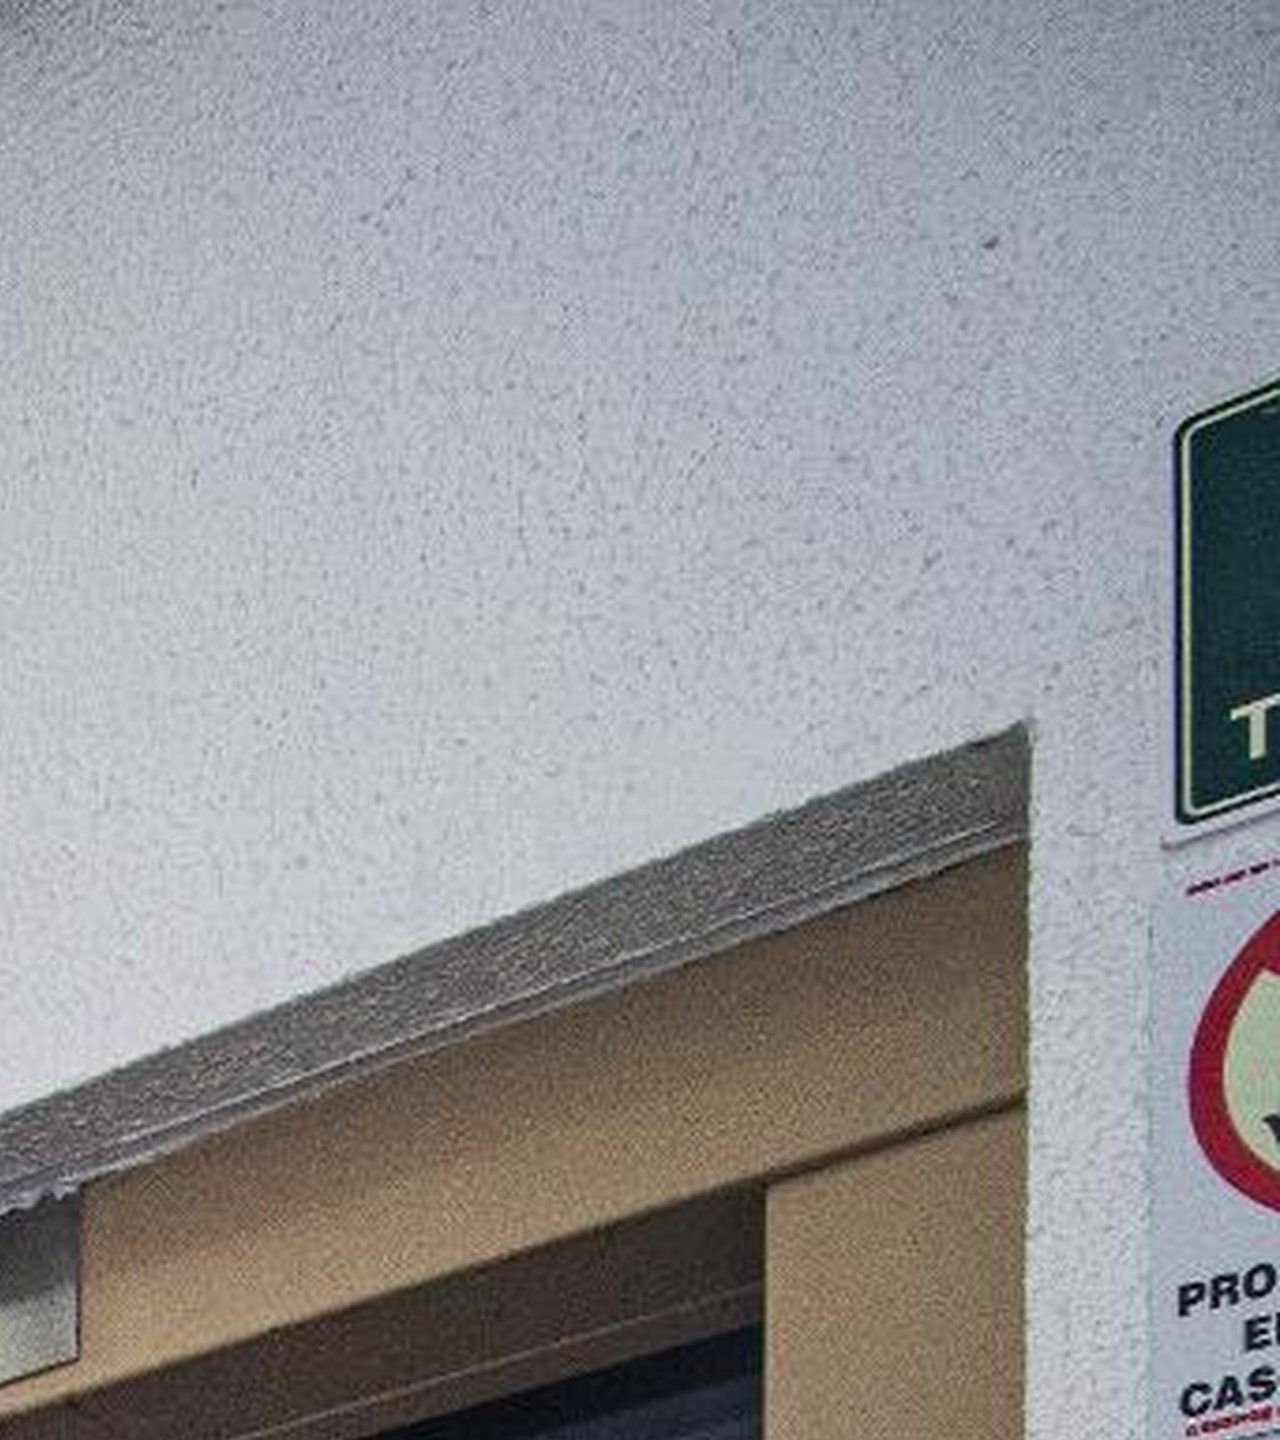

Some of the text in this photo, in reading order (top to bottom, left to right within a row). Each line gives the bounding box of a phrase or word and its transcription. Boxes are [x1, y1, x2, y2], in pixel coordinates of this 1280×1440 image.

[1230, 693, 1280, 760] T
[1177, 1263, 1277, 1317] PRO
[1243, 1311, 1280, 1353] E
[1179, 1365, 1276, 1418] CAS
